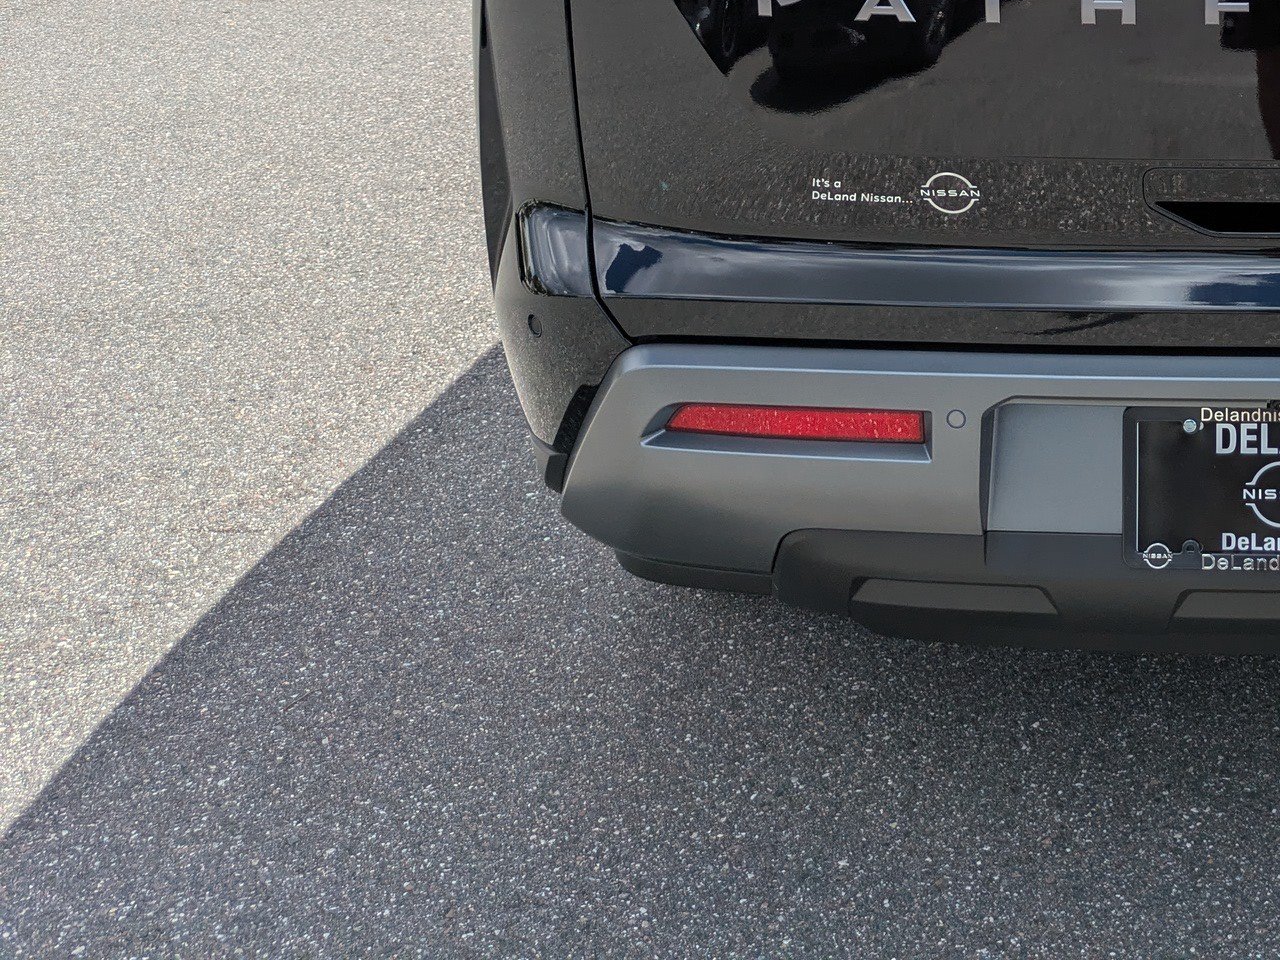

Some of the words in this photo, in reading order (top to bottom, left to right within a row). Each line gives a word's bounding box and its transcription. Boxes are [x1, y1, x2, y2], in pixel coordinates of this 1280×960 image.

[812, 178, 830, 188] It's
[833, 180, 842, 189] a
[811, 190, 857, 202] DeLand
[860, 193, 914, 204] Nissan...
[920, 189, 981, 198] NISSAN
[1201, 553, 1280, 571] DeLand
